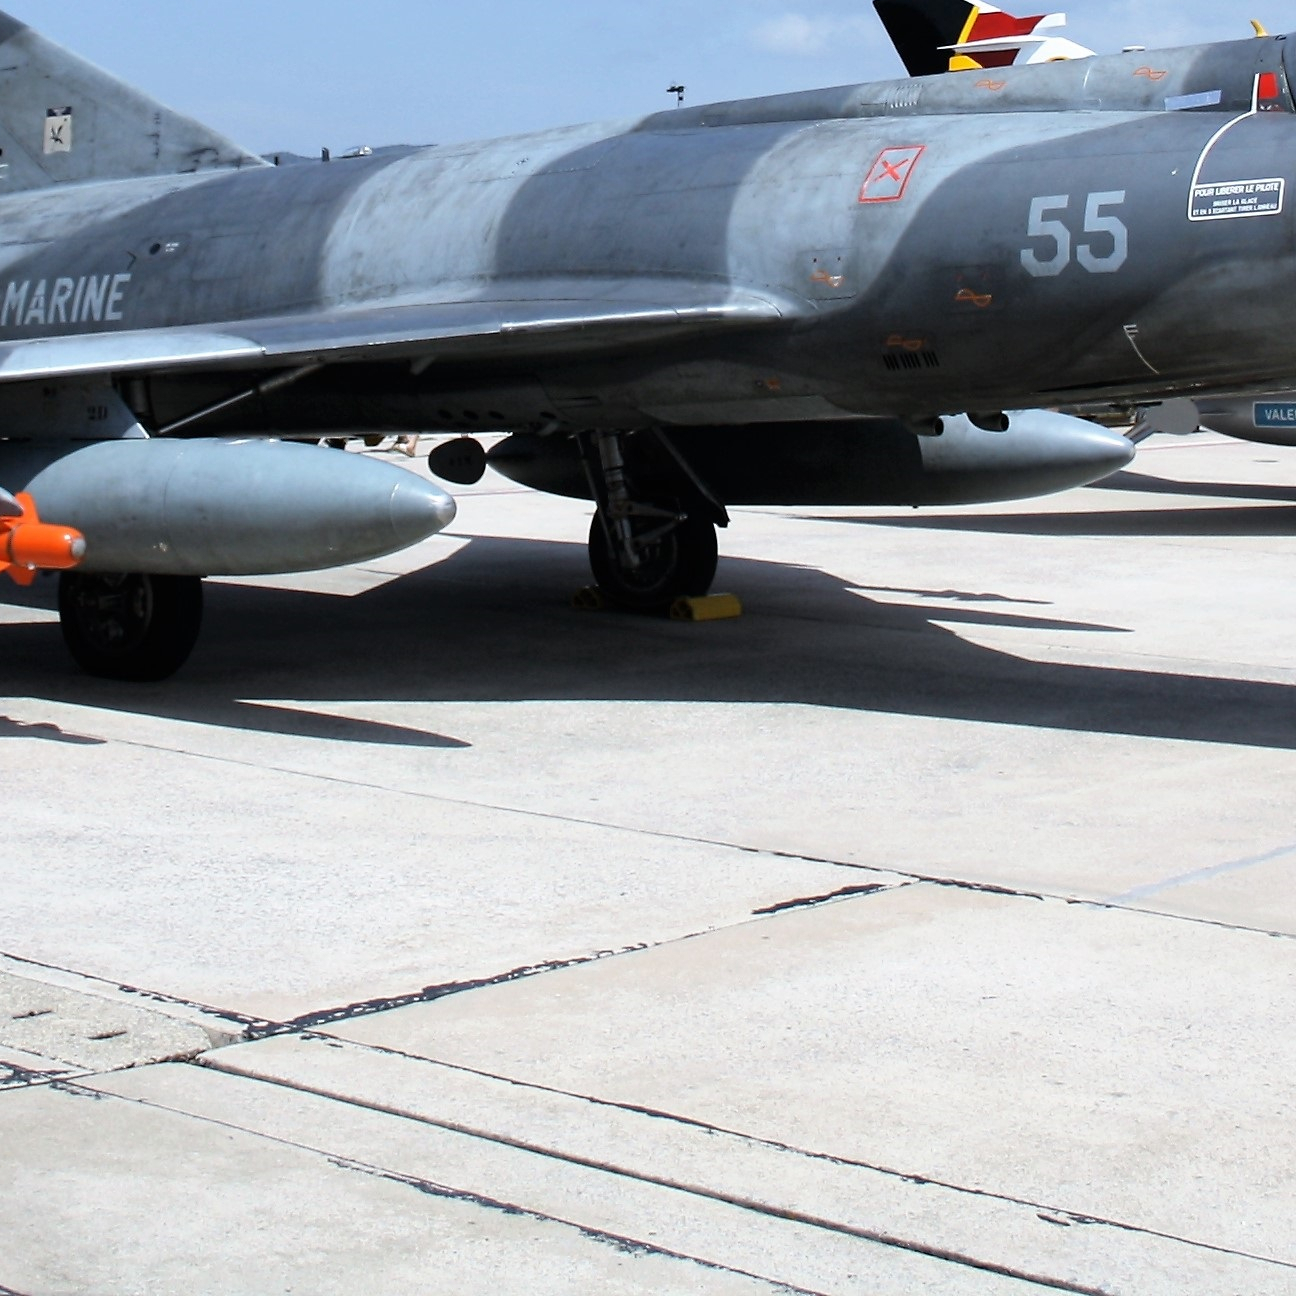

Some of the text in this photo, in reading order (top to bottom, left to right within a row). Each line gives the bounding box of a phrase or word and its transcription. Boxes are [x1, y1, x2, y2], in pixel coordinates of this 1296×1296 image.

[1194, 183, 1279, 197] POUR LIBERER LE PILOTE
[1020, 190, 1128, 277] 55
[0, 273, 132, 326] MARINE
